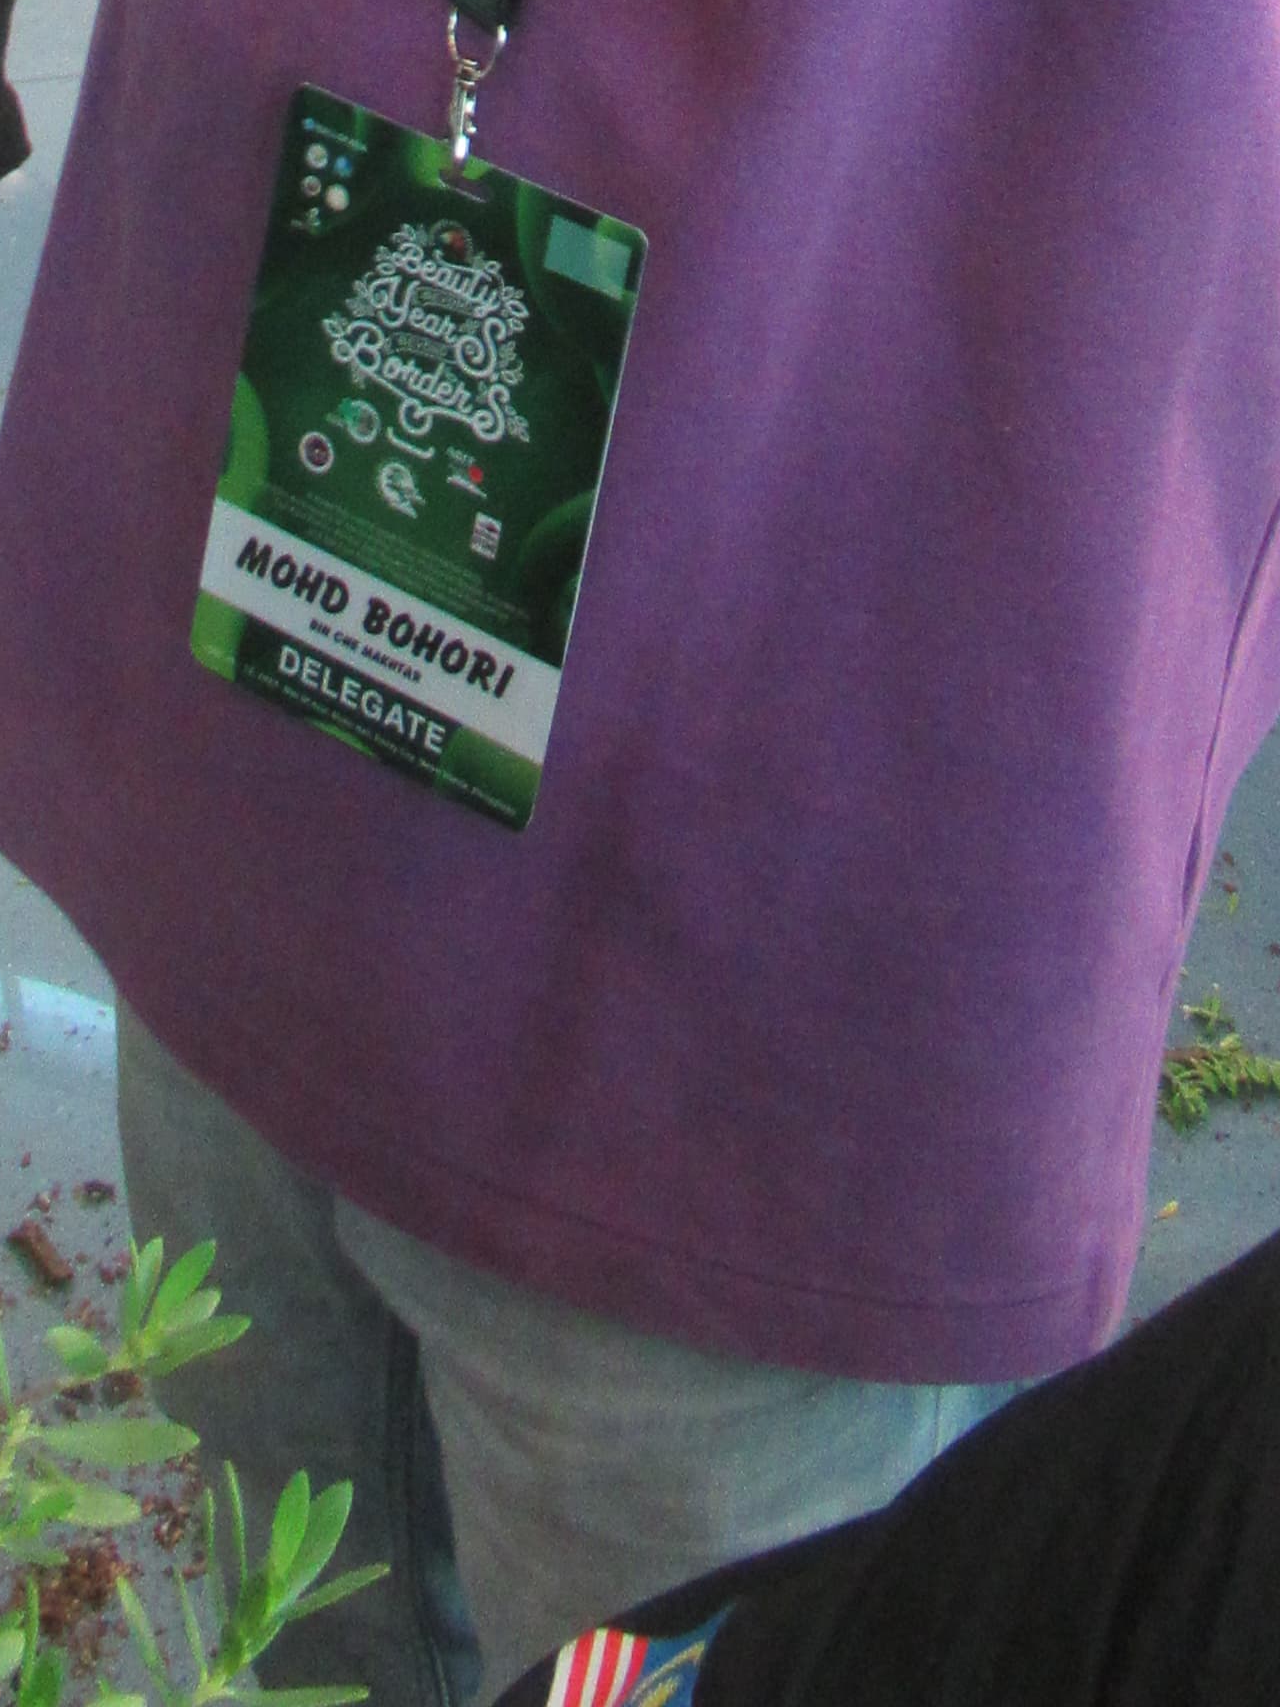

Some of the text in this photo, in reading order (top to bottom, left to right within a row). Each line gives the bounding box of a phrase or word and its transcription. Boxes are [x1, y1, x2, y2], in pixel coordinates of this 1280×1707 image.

[235, 536, 351, 614] MOHD
[361, 595, 516, 699] BOHORI
[277, 645, 447, 756] DELEGATE
